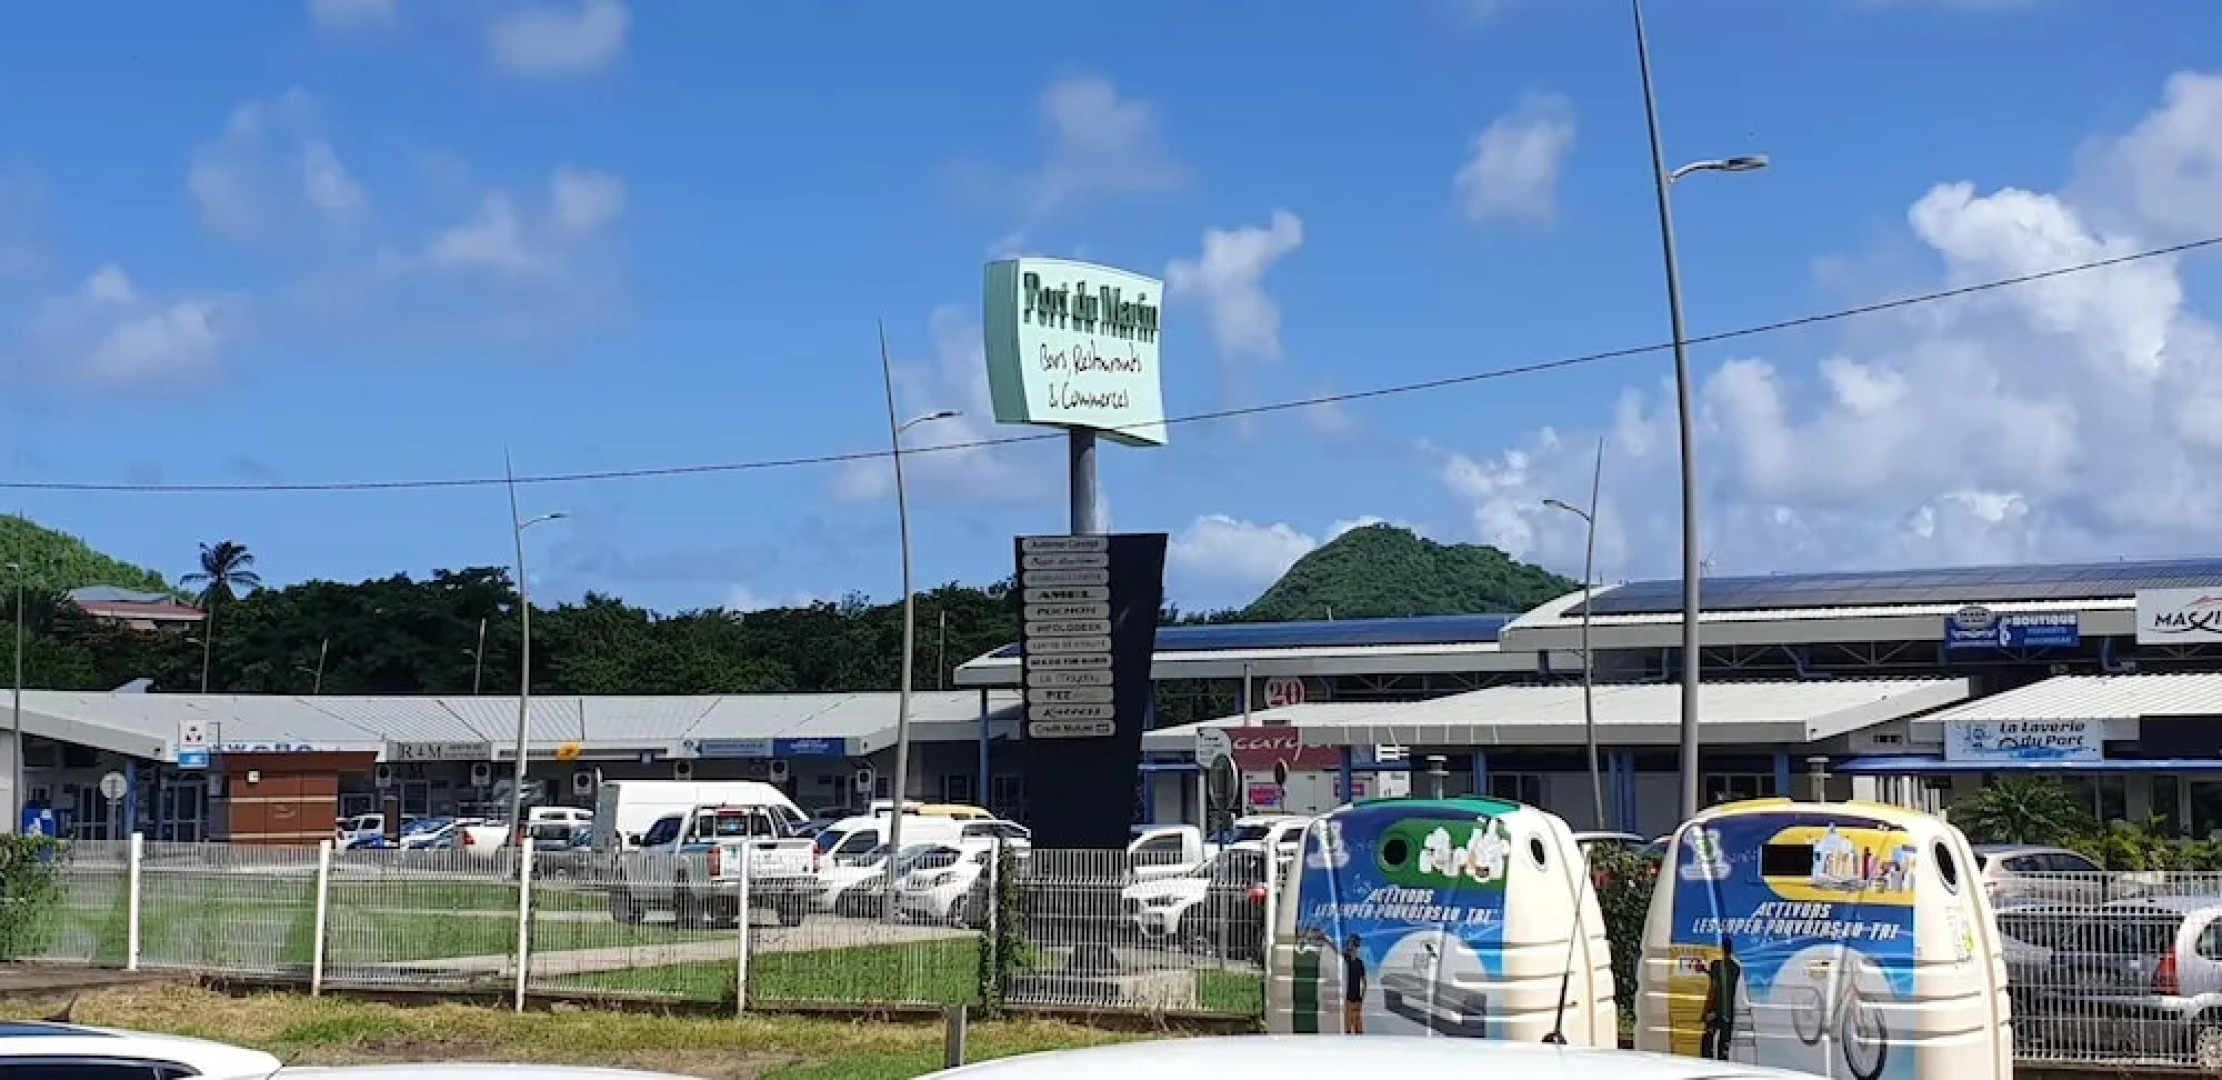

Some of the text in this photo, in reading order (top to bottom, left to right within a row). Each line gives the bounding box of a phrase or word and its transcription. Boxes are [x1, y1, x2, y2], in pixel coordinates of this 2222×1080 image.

[1023, 271, 1160, 344] Port du Marin
[1073, 338, 1142, 374] Restaurants
[1062, 382, 1129, 409] Commerces
[2012, 613, 2077, 626] BOUTIQUE
[1269, 681, 1301, 705] 20
[2020, 721, 2085, 732] Laverie
[2020, 735, 2085, 748] du Port
[1363, 888, 1434, 903] ACTIVONS
[1751, 902, 1831, 919] ACTIVONS
[1693, 918, 1719, 934] LES
[1870, 922, 1900, 941] TRI
